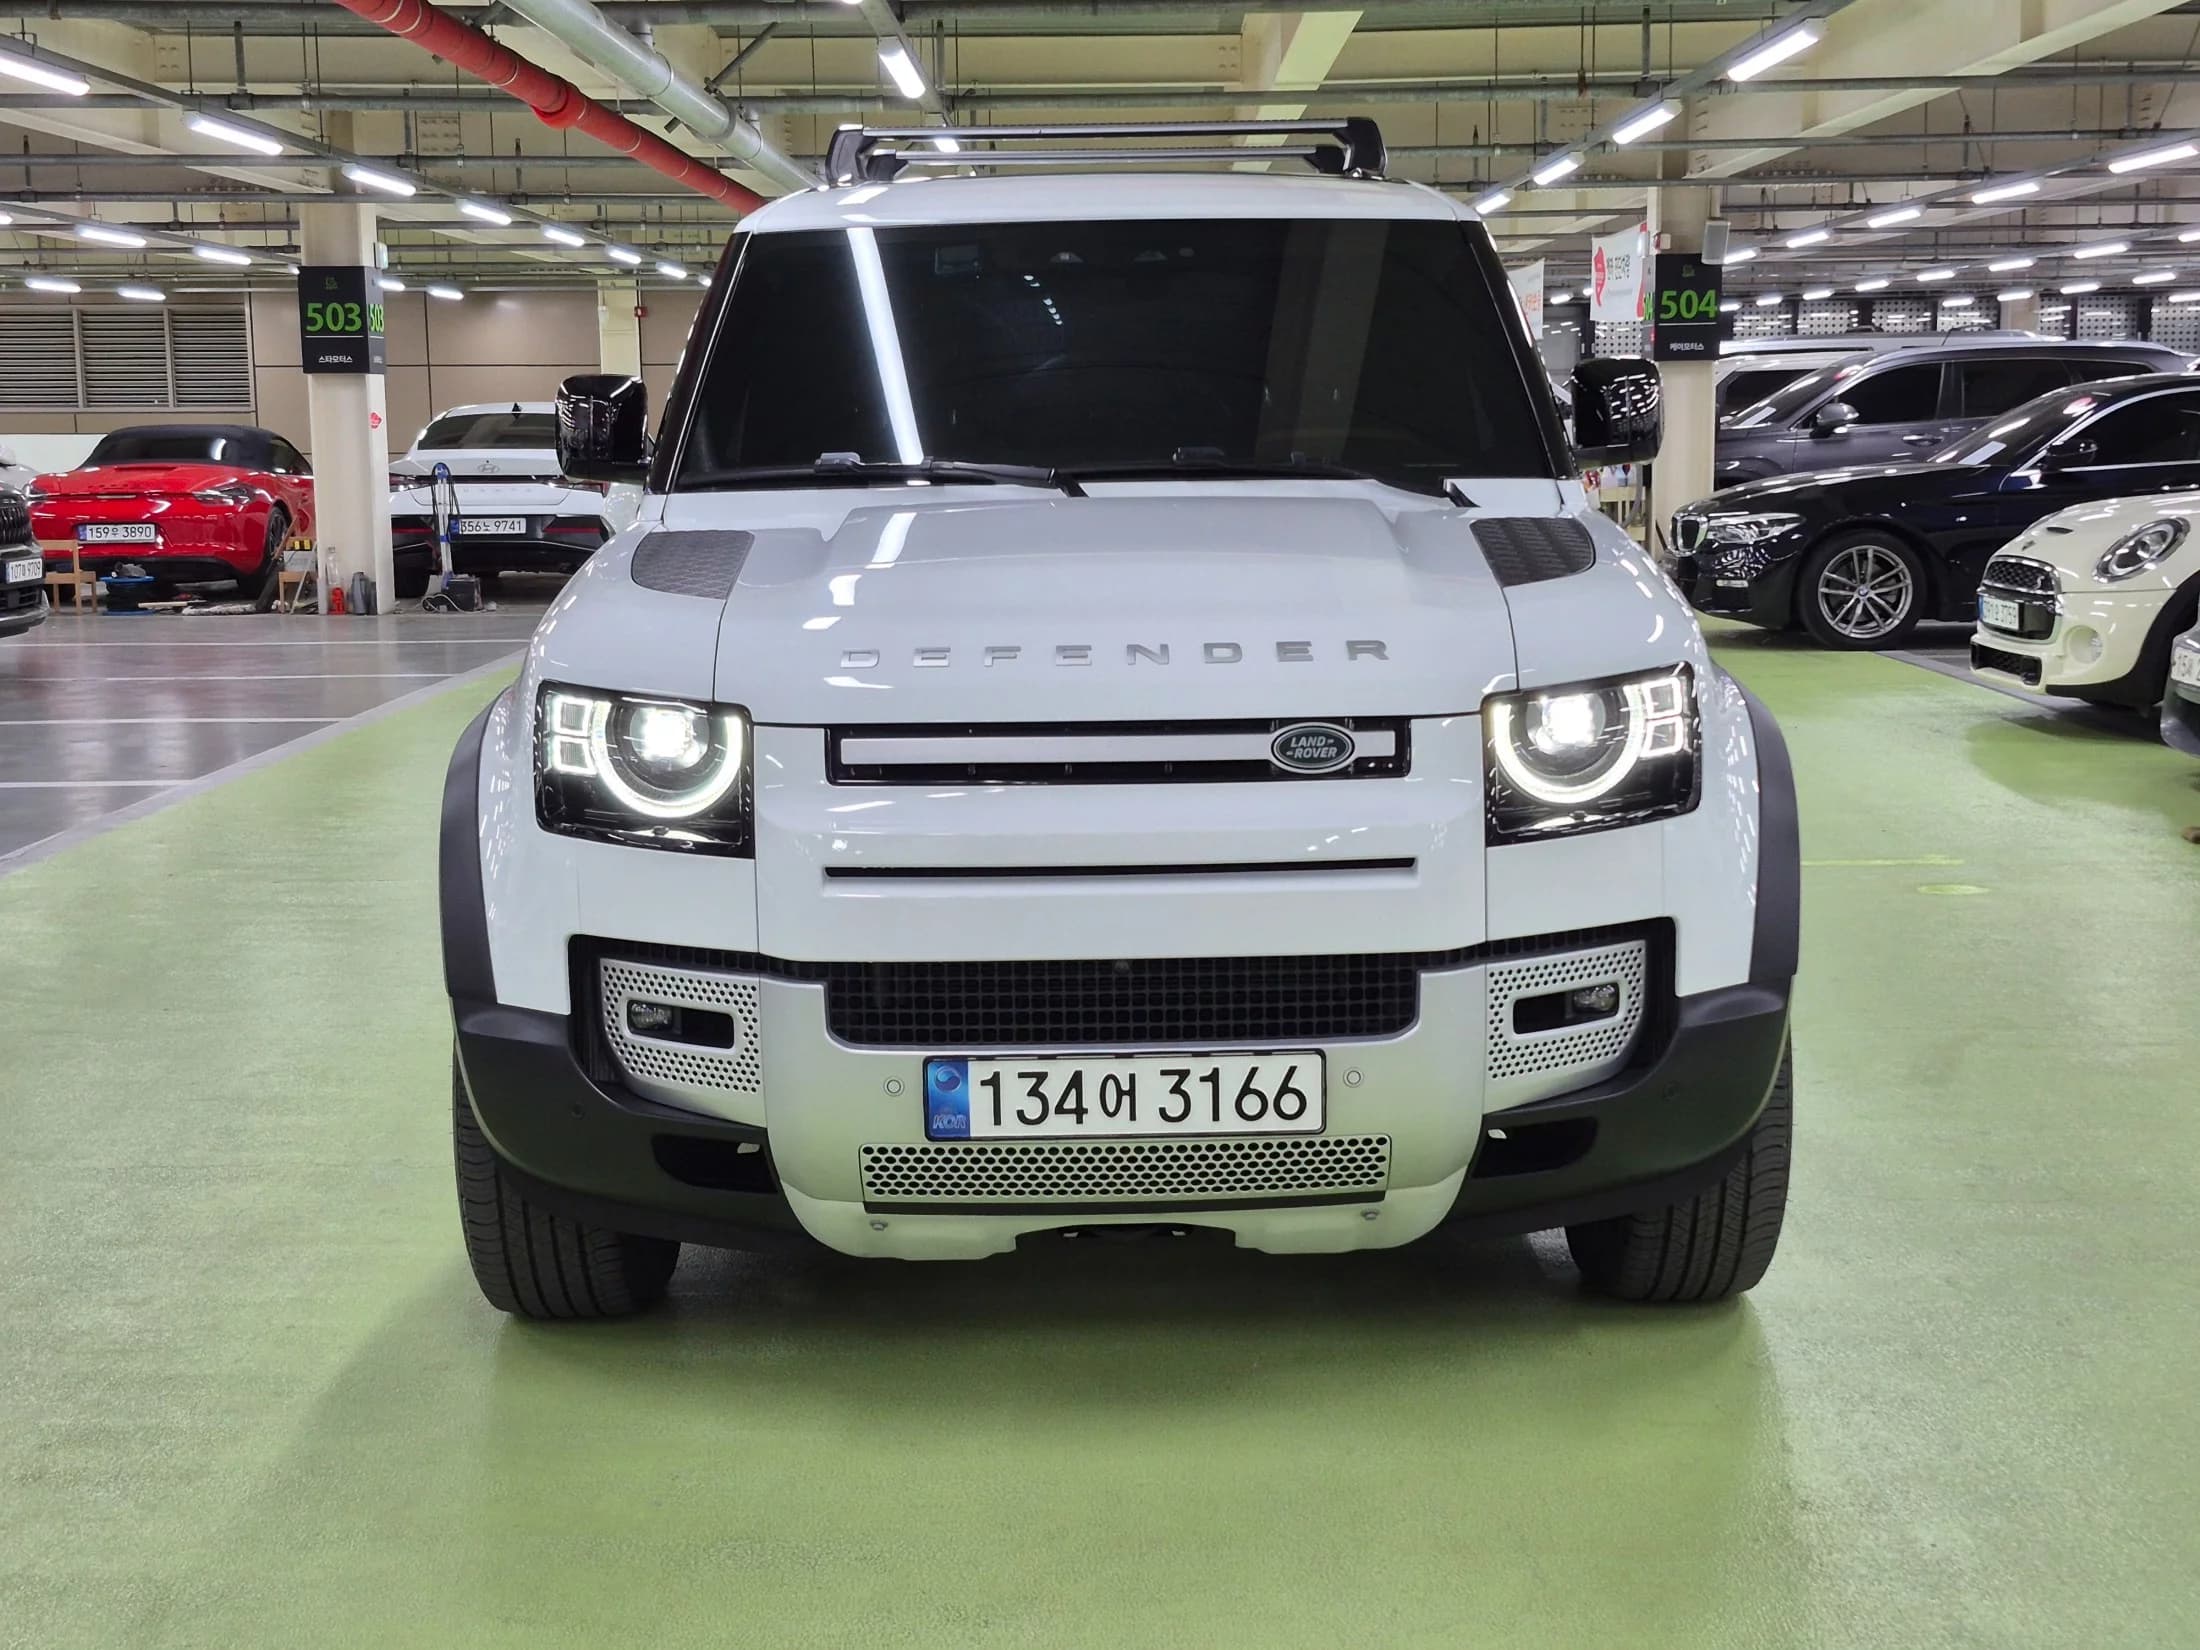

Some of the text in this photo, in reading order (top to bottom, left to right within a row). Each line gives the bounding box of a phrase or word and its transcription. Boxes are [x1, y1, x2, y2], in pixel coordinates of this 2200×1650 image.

[306, 302, 362, 332] 503
[369, 303, 384, 332] 503
[1660, 289, 1717, 319] 504
[318, 355, 353, 364] 스타모터스
[122, 526, 152, 538] 3890
[460, 520, 521, 533] 356노 9741
[840, 640, 1390, 669] DEFENDER
[980, 1065, 1307, 1126] 134어 3166
[932, 1114, 967, 1129] KOR
